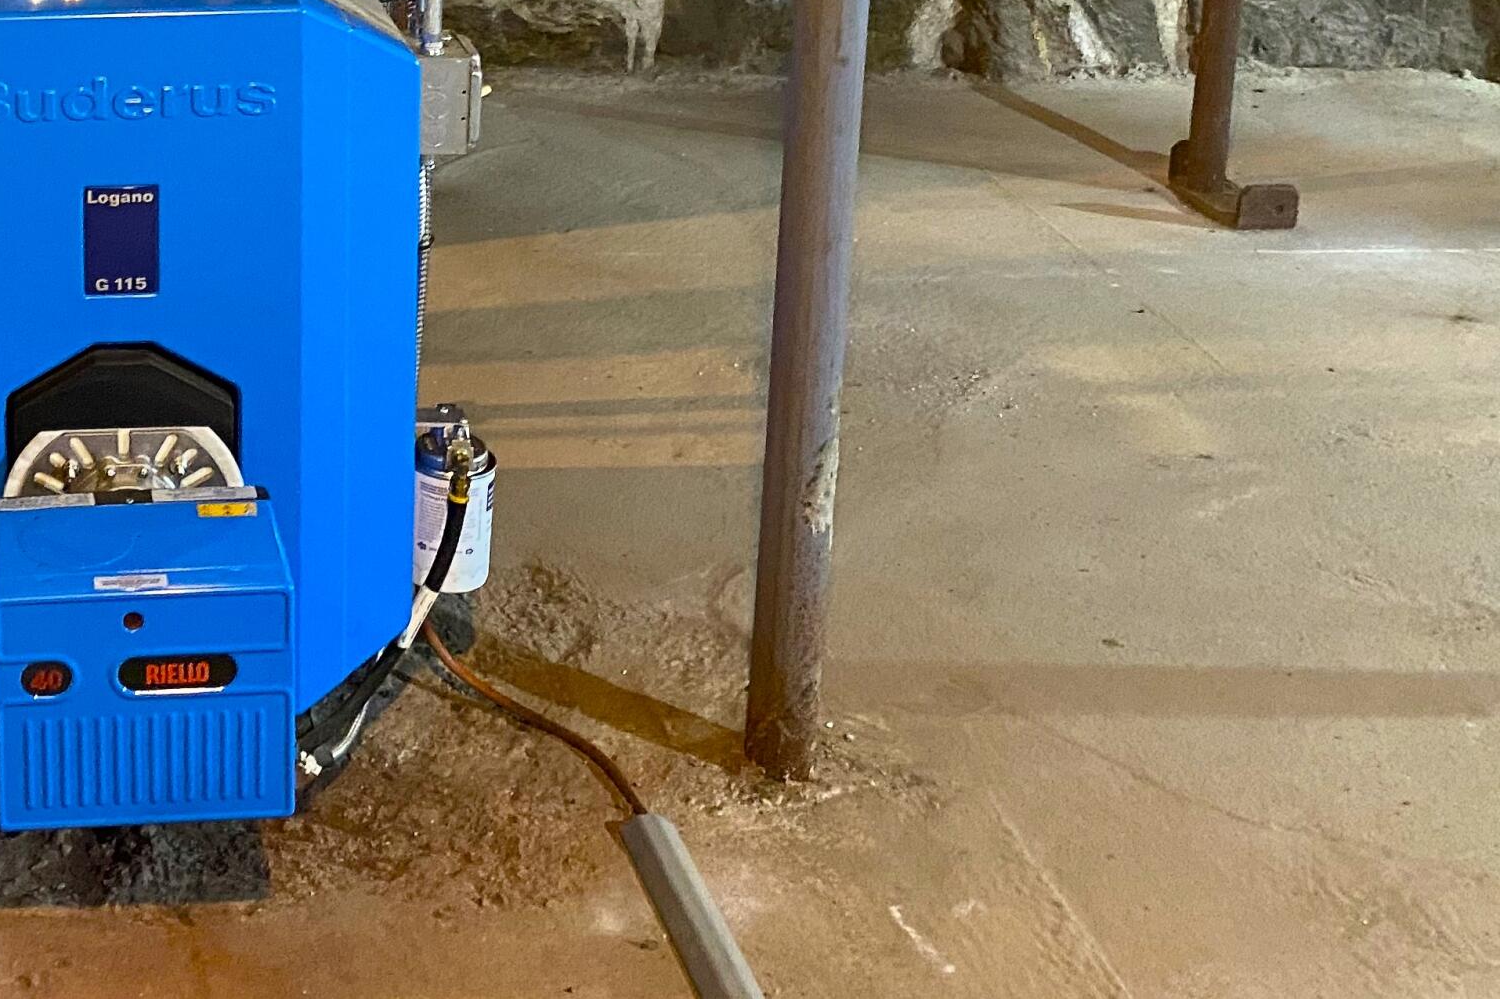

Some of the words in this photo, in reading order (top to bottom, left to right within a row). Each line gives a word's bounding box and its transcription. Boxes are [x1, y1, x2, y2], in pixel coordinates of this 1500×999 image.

[87, 190, 154, 207] Logano
[95, 278, 109, 291] G
[114, 277, 147, 291] 115
[30, 670, 63, 690] 40
[146, 661, 210, 685] RIELLO
